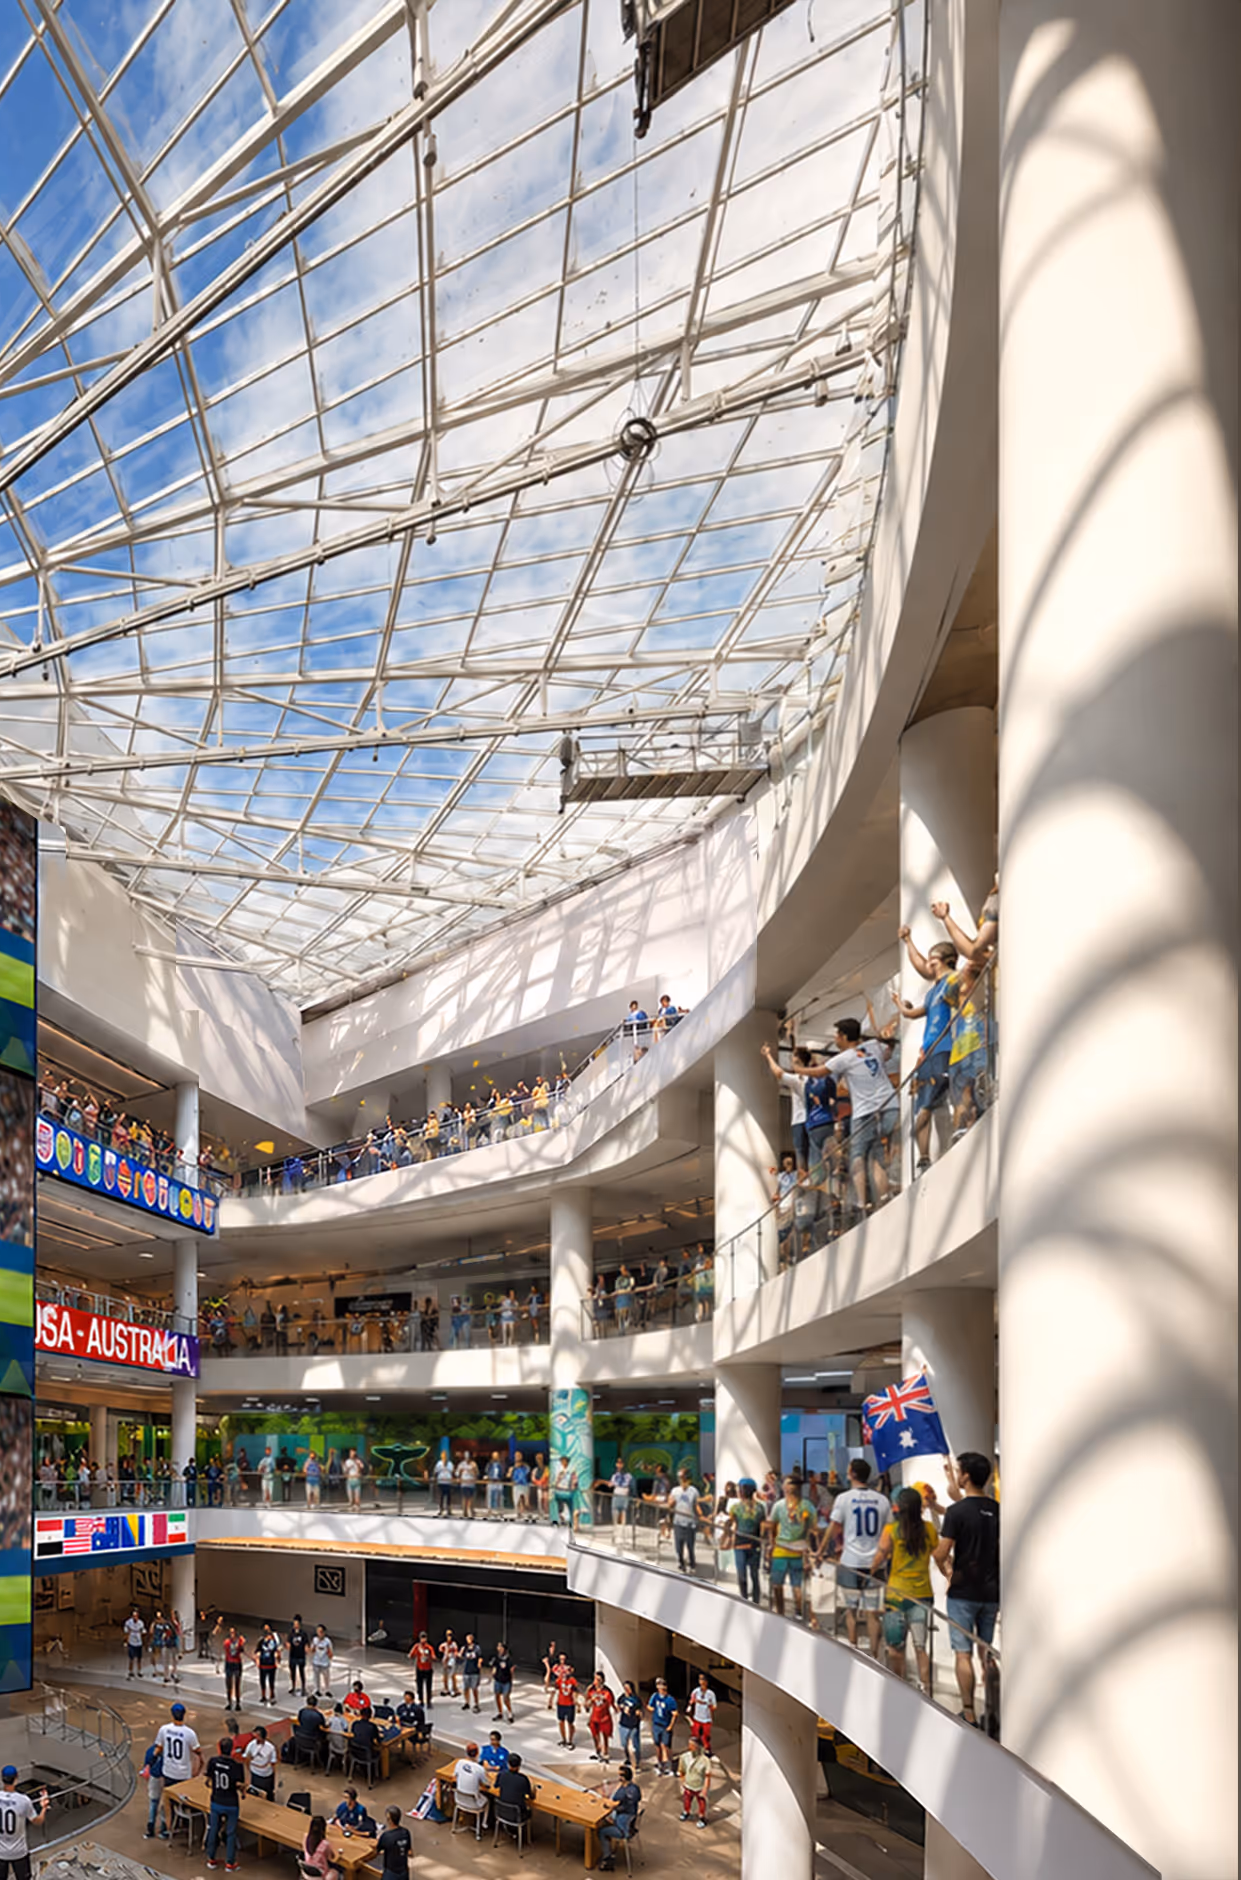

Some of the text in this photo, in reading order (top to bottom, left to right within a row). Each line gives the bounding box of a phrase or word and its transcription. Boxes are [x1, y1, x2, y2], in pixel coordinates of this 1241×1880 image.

[852, 1505, 879, 1537] 10
[166, 1736, 184, 1760] 10
[214, 1770, 230, 1790] 10
